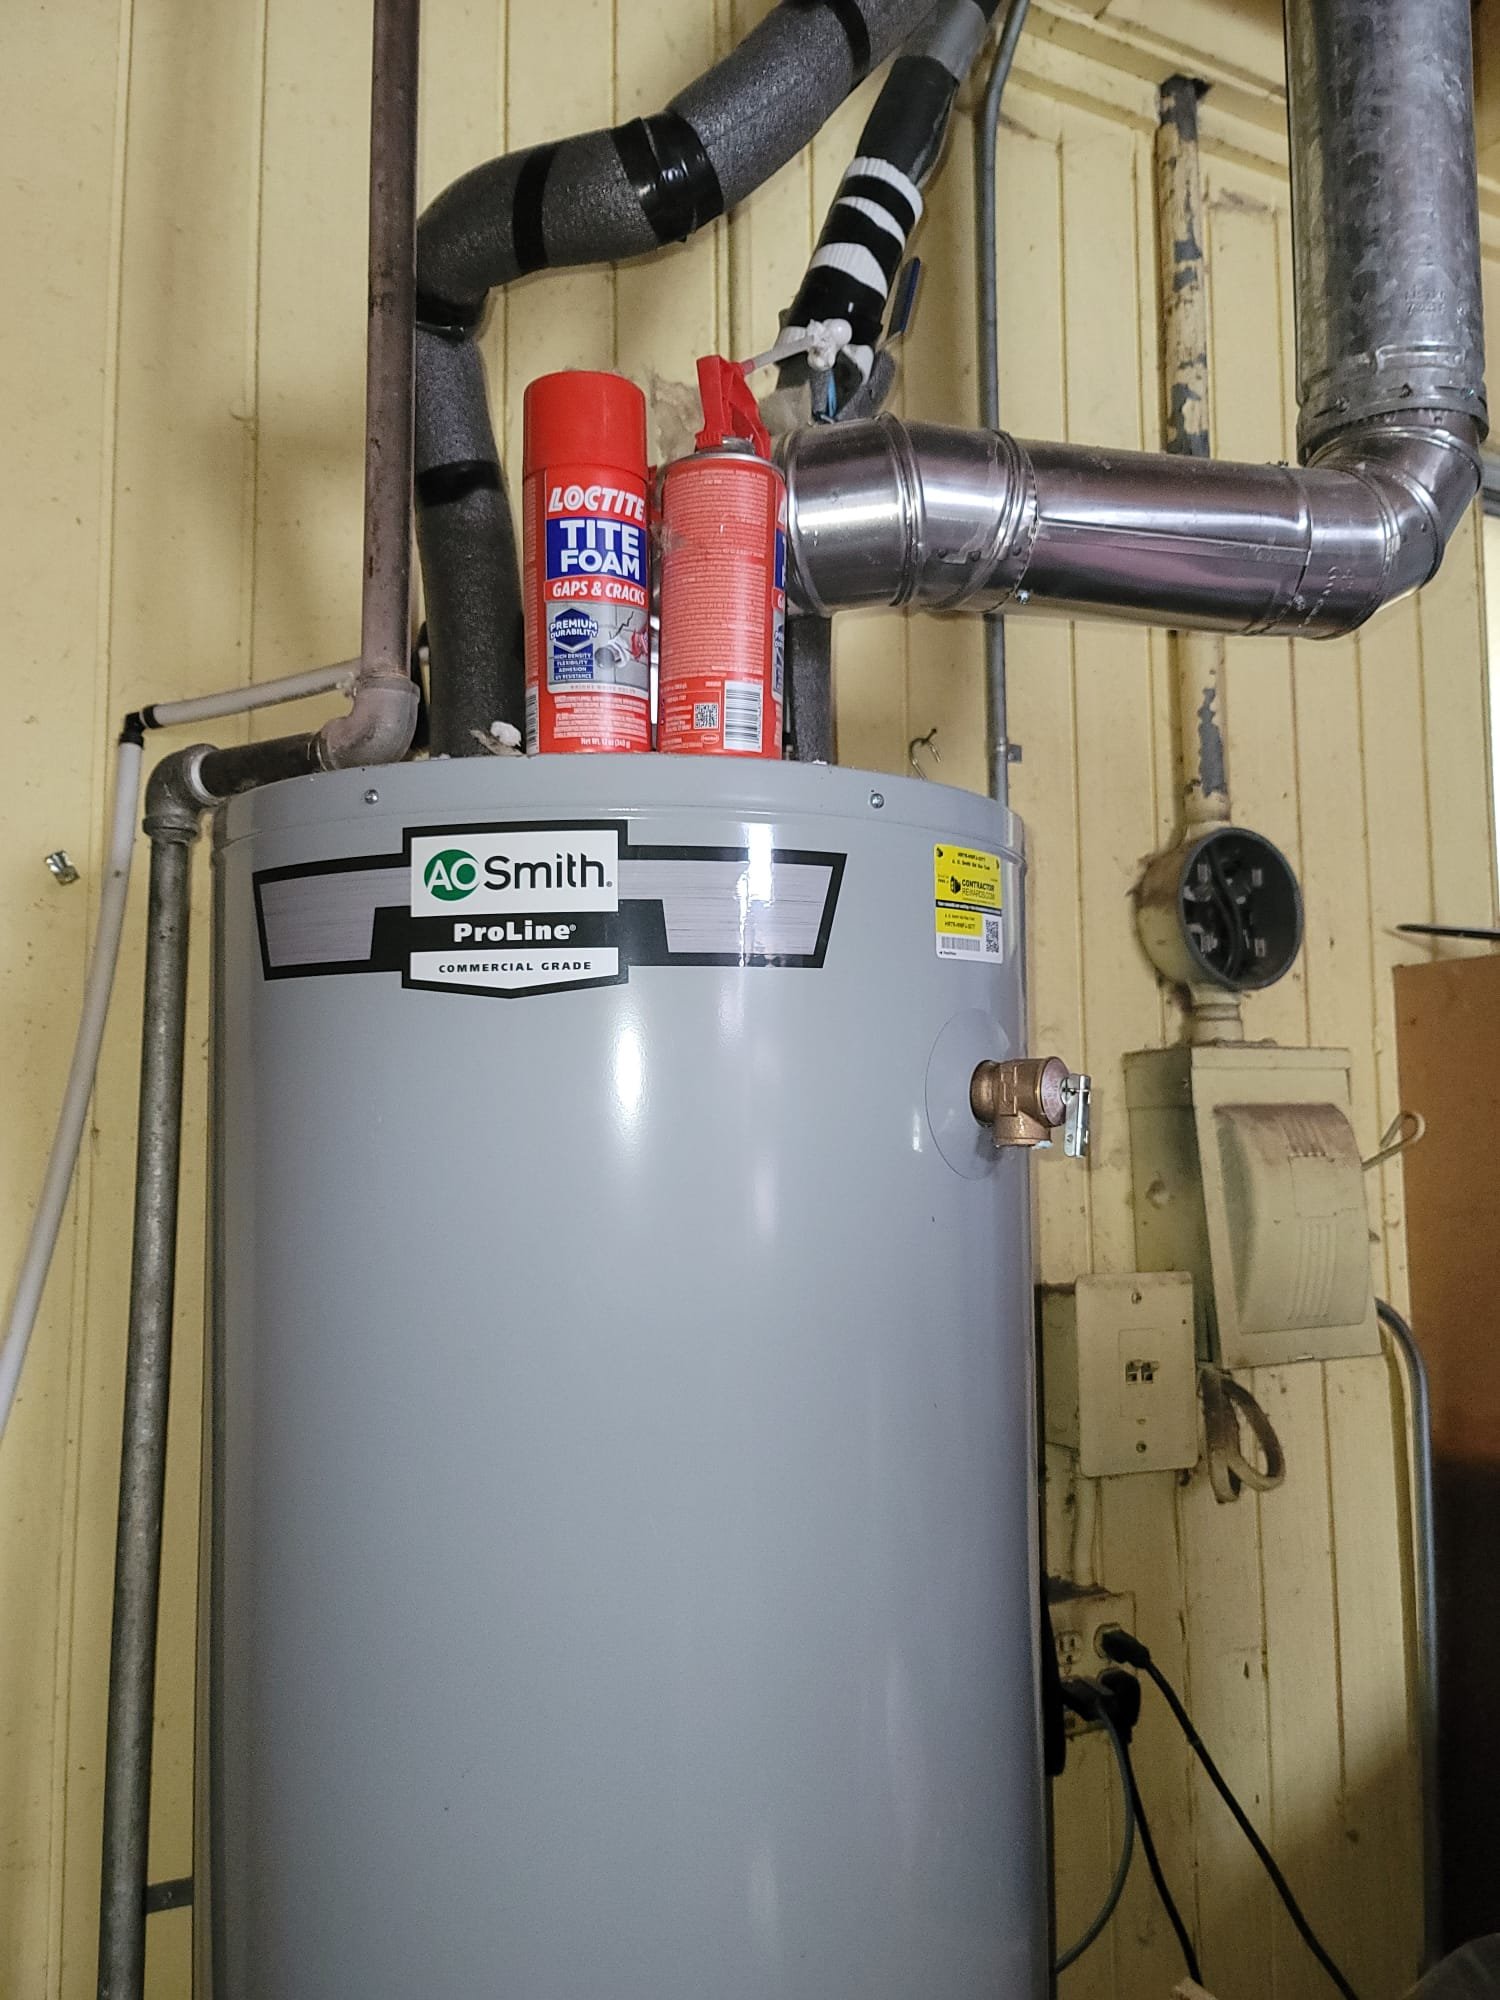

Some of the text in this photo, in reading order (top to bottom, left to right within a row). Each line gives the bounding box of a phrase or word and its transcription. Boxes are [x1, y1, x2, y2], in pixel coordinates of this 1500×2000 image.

[548, 485, 646, 521] LOCTITE
[559, 519, 640, 558] TITE
[561, 549, 640, 580] FOAM
[552, 581, 645, 605] GAPS & CRACKS
[550, 617, 598, 631] PREMIUM
[550, 628, 598, 641] DURABILITY
[567, 652, 592, 660] DENSITY
[426, 853, 605, 892] AO Smith
[961, 878, 995, 892] CONTRACTOR
[453, 920, 571, 943] ProLine
[438, 961, 592, 974] COMMERCIAL GRADE
